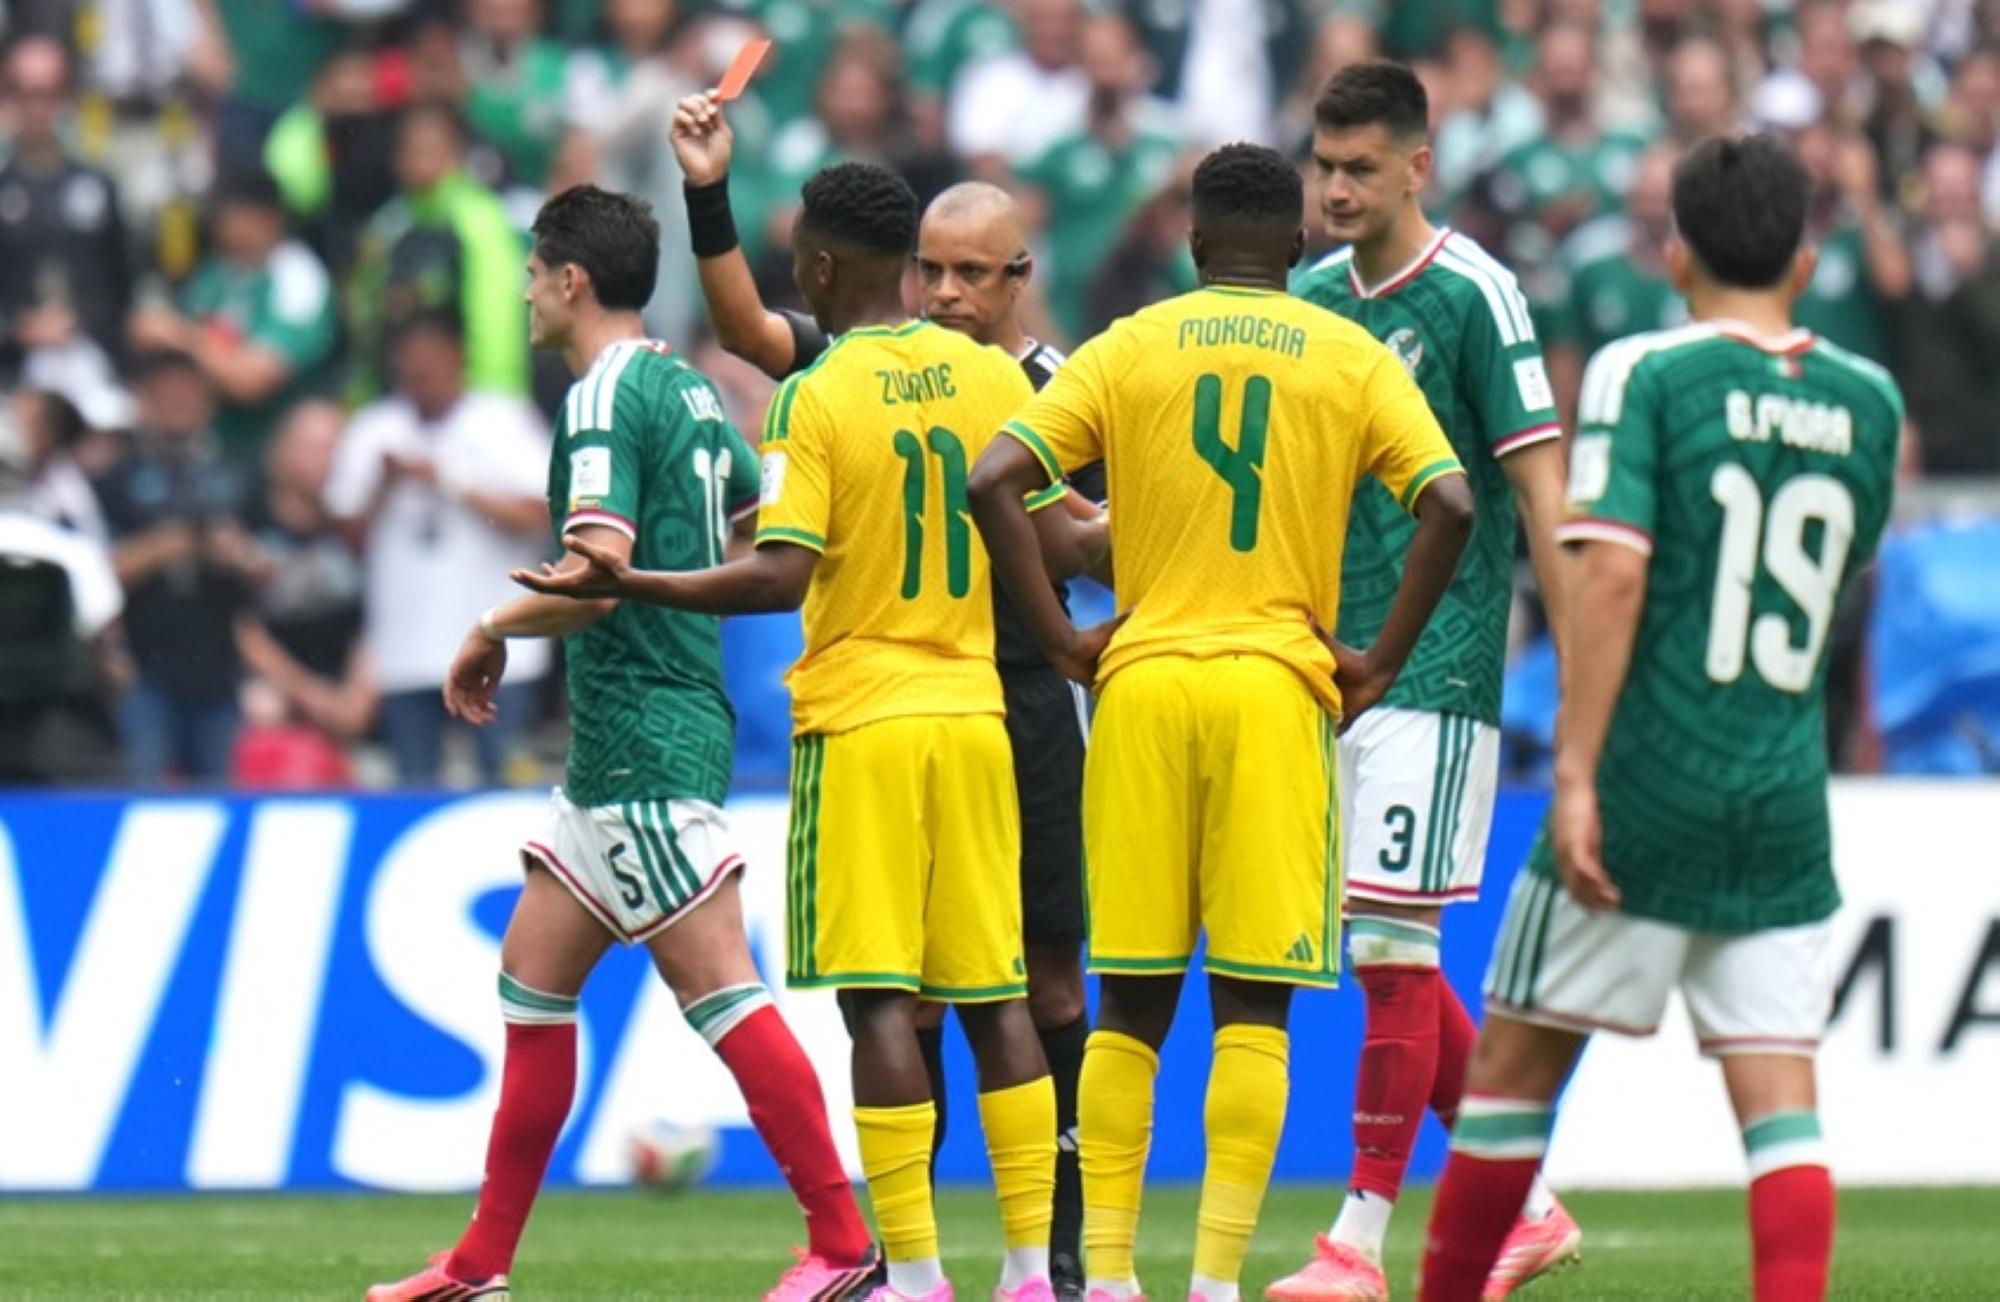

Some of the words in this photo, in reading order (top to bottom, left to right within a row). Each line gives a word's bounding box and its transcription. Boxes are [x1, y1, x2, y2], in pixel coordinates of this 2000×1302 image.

[875, 363, 957, 405] ZWANE
[1179, 315, 1306, 359] MOKOENA
[893, 425, 971, 600] 11
[1192, 373, 1272, 552] 4
[1706, 461, 1856, 692] 19
[1379, 804, 1416, 873] 3
[0, 791, 868, 1192] VISA
